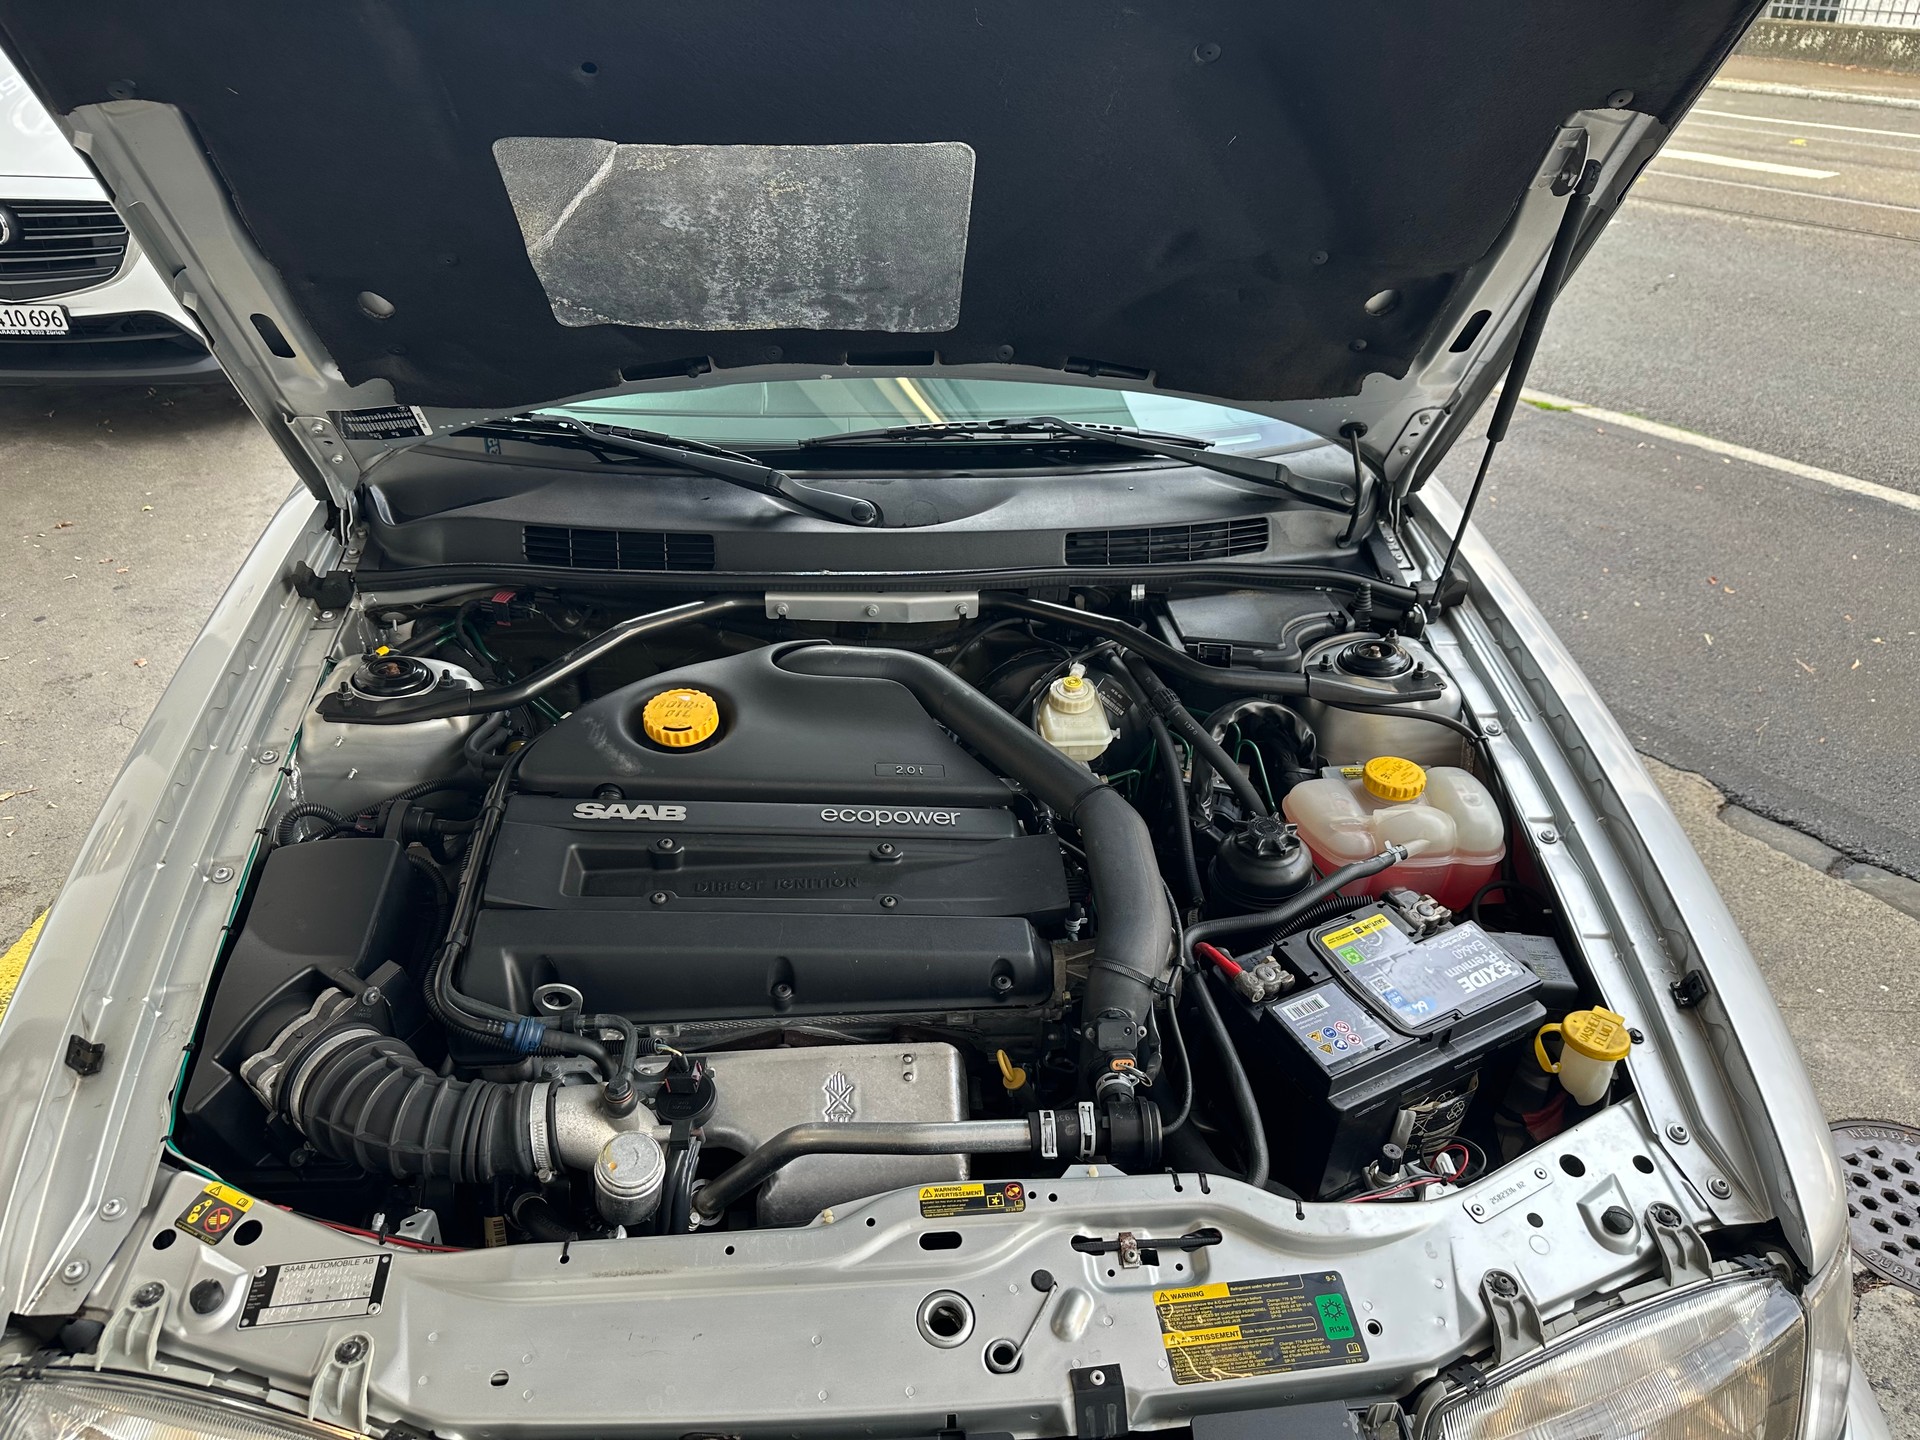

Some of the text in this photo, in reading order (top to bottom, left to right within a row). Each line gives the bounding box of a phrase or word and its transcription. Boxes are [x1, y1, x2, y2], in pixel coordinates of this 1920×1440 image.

[573, 802, 687, 821] SAAB
[820, 807, 961, 826] ecopower
[694, 877, 861, 893] DIRECT IGNITION
[1451, 939, 1487, 959] EA640
[1444, 950, 1504, 979] Premium
[1456, 960, 1514, 993] EXIDE
[934, 1190, 982, 1198] AVERTISSEMENT
[284, 1265, 306, 1273] SAAB
[308, 1259, 360, 1270] AUTOMOBILE
[1170, 1290, 1204, 1299] WARNING
[1328, 1324, 1350, 1333] R134a
